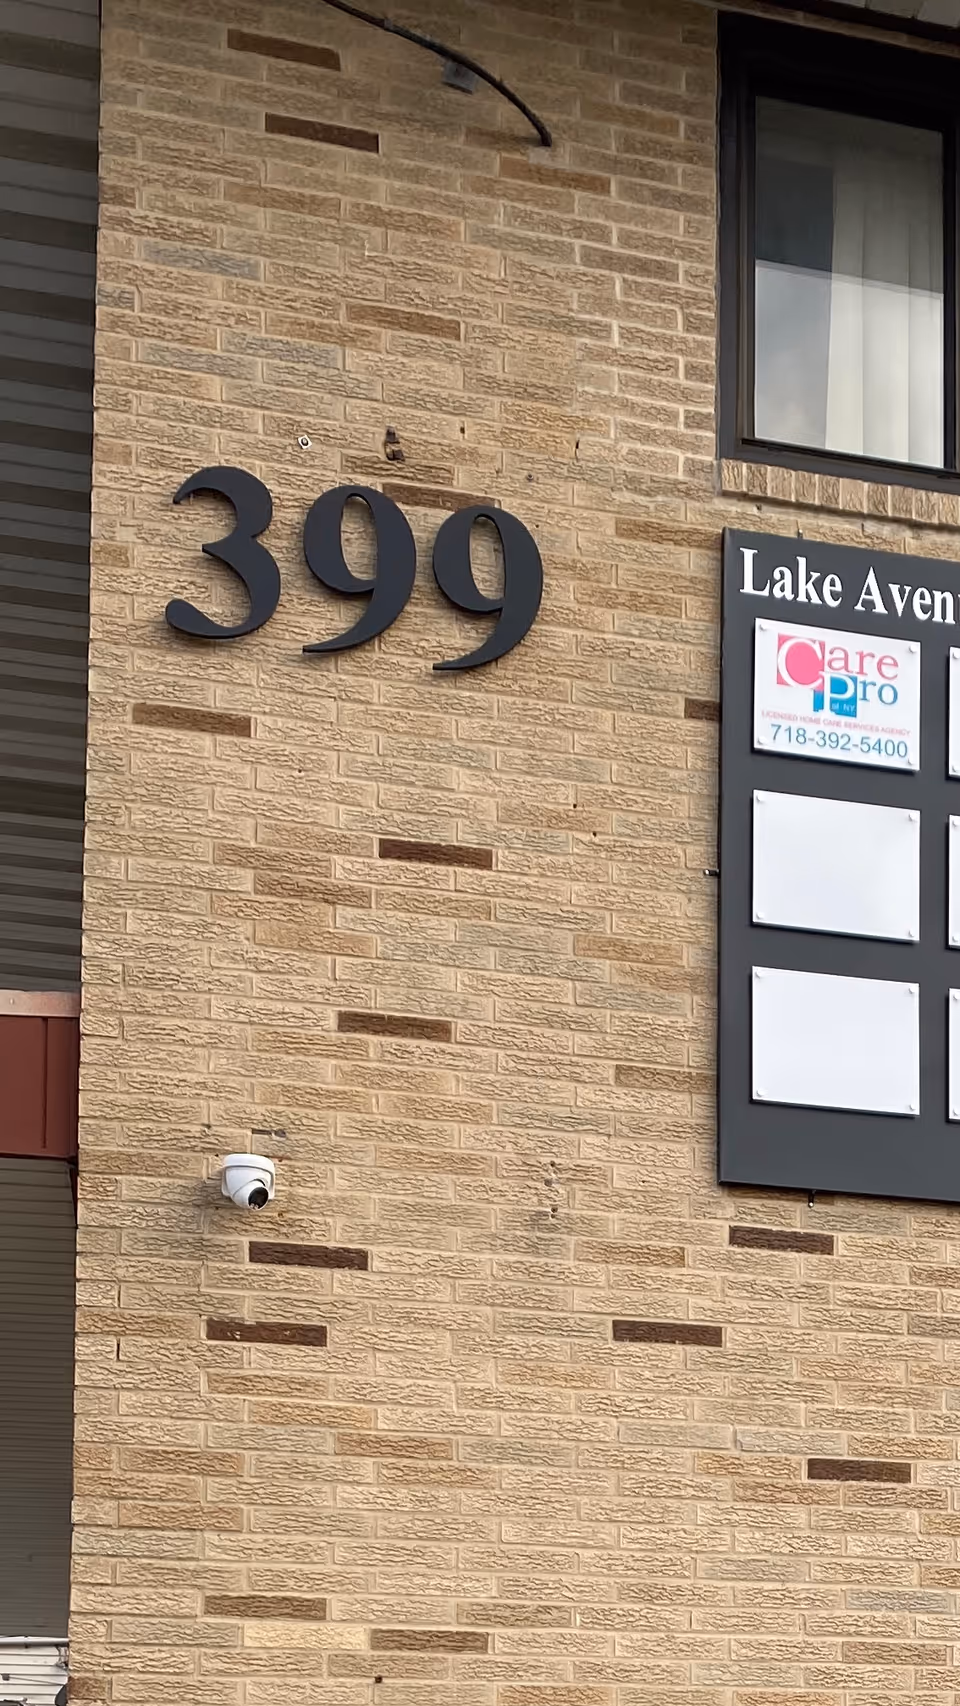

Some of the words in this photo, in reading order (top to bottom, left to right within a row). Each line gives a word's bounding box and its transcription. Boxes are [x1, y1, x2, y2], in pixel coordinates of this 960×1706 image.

[164, 465, 544, 671] 399
[739, 547, 843, 608] Lake
[777, 636, 899, 690] Care
[819, 671, 899, 715] Pro
[770, 723, 908, 758] 718-392-5400
